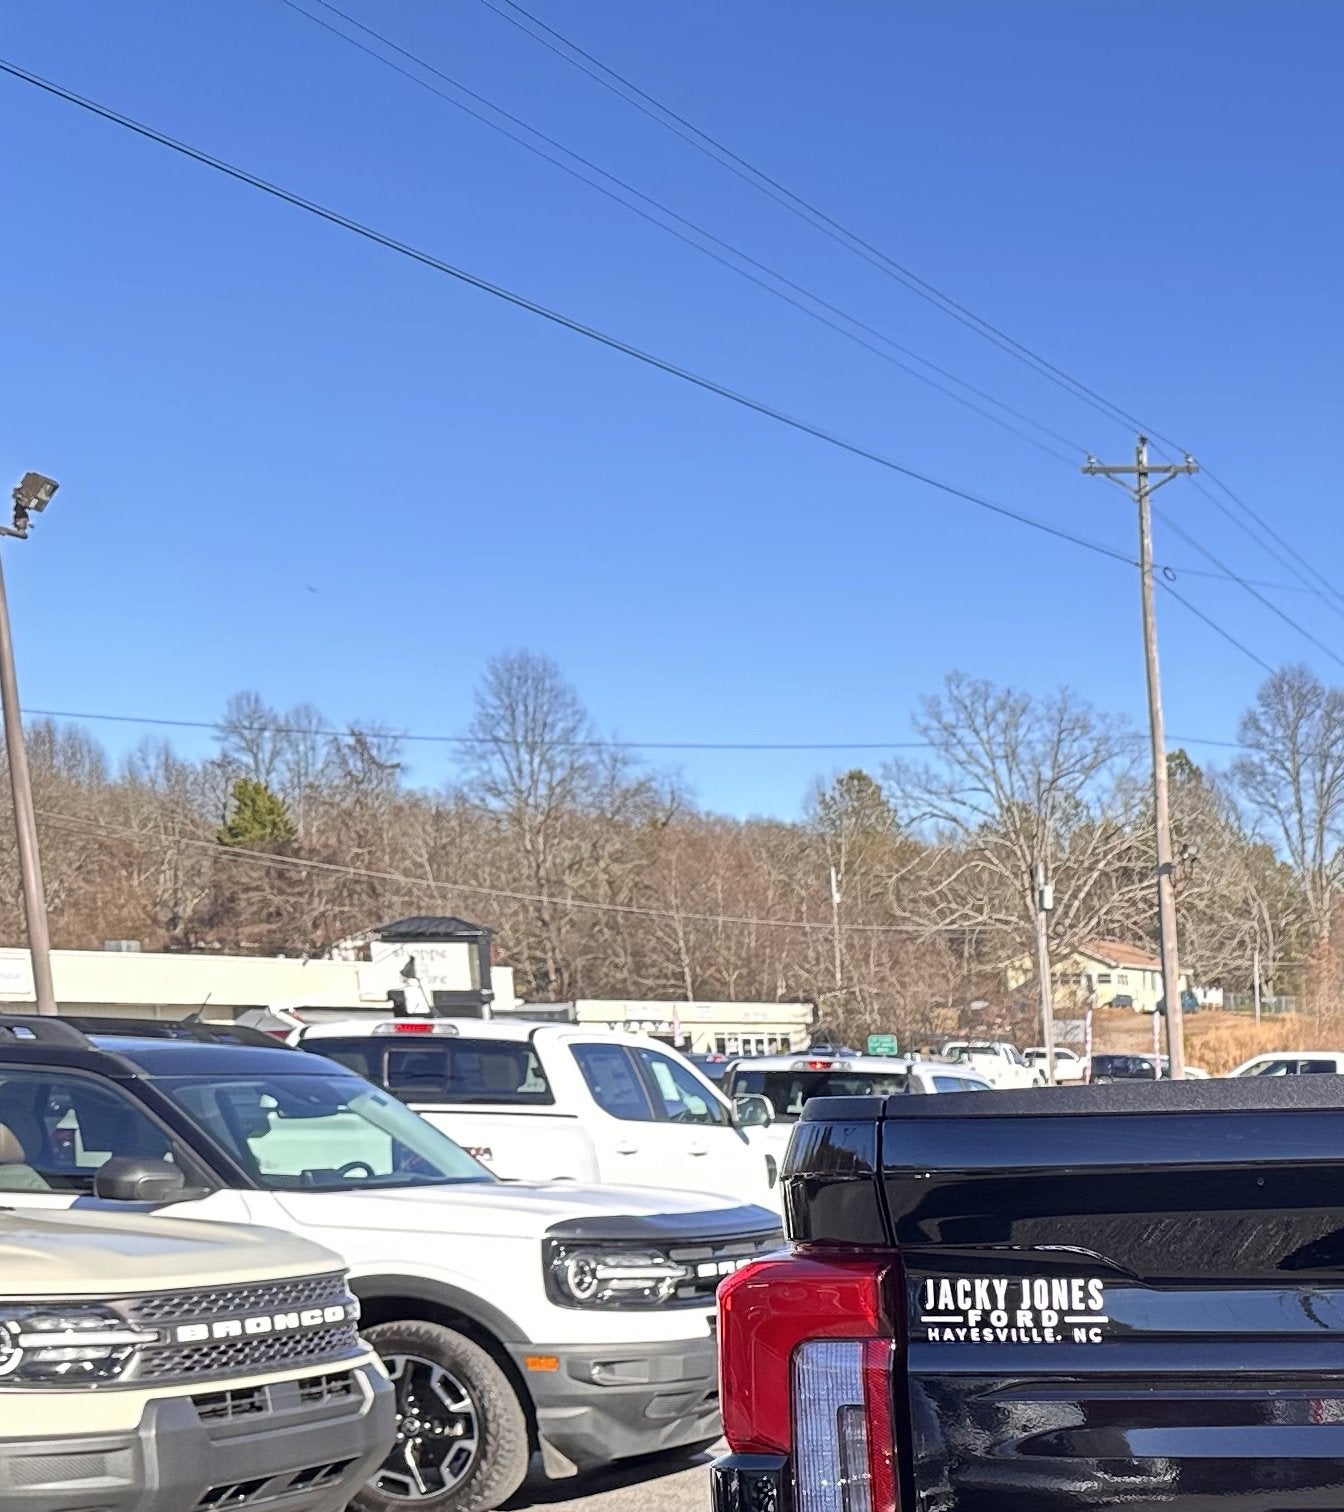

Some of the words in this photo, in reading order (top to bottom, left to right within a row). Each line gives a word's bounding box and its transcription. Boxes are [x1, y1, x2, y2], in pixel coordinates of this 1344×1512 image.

[925, 1278, 1008, 1311] JACKY
[1020, 1278, 1104, 1311] JONES
[177, 1305, 345, 1343] BRONCO
[967, 1309, 1059, 1328] FORD
[1073, 1327, 1103, 1344] NC
